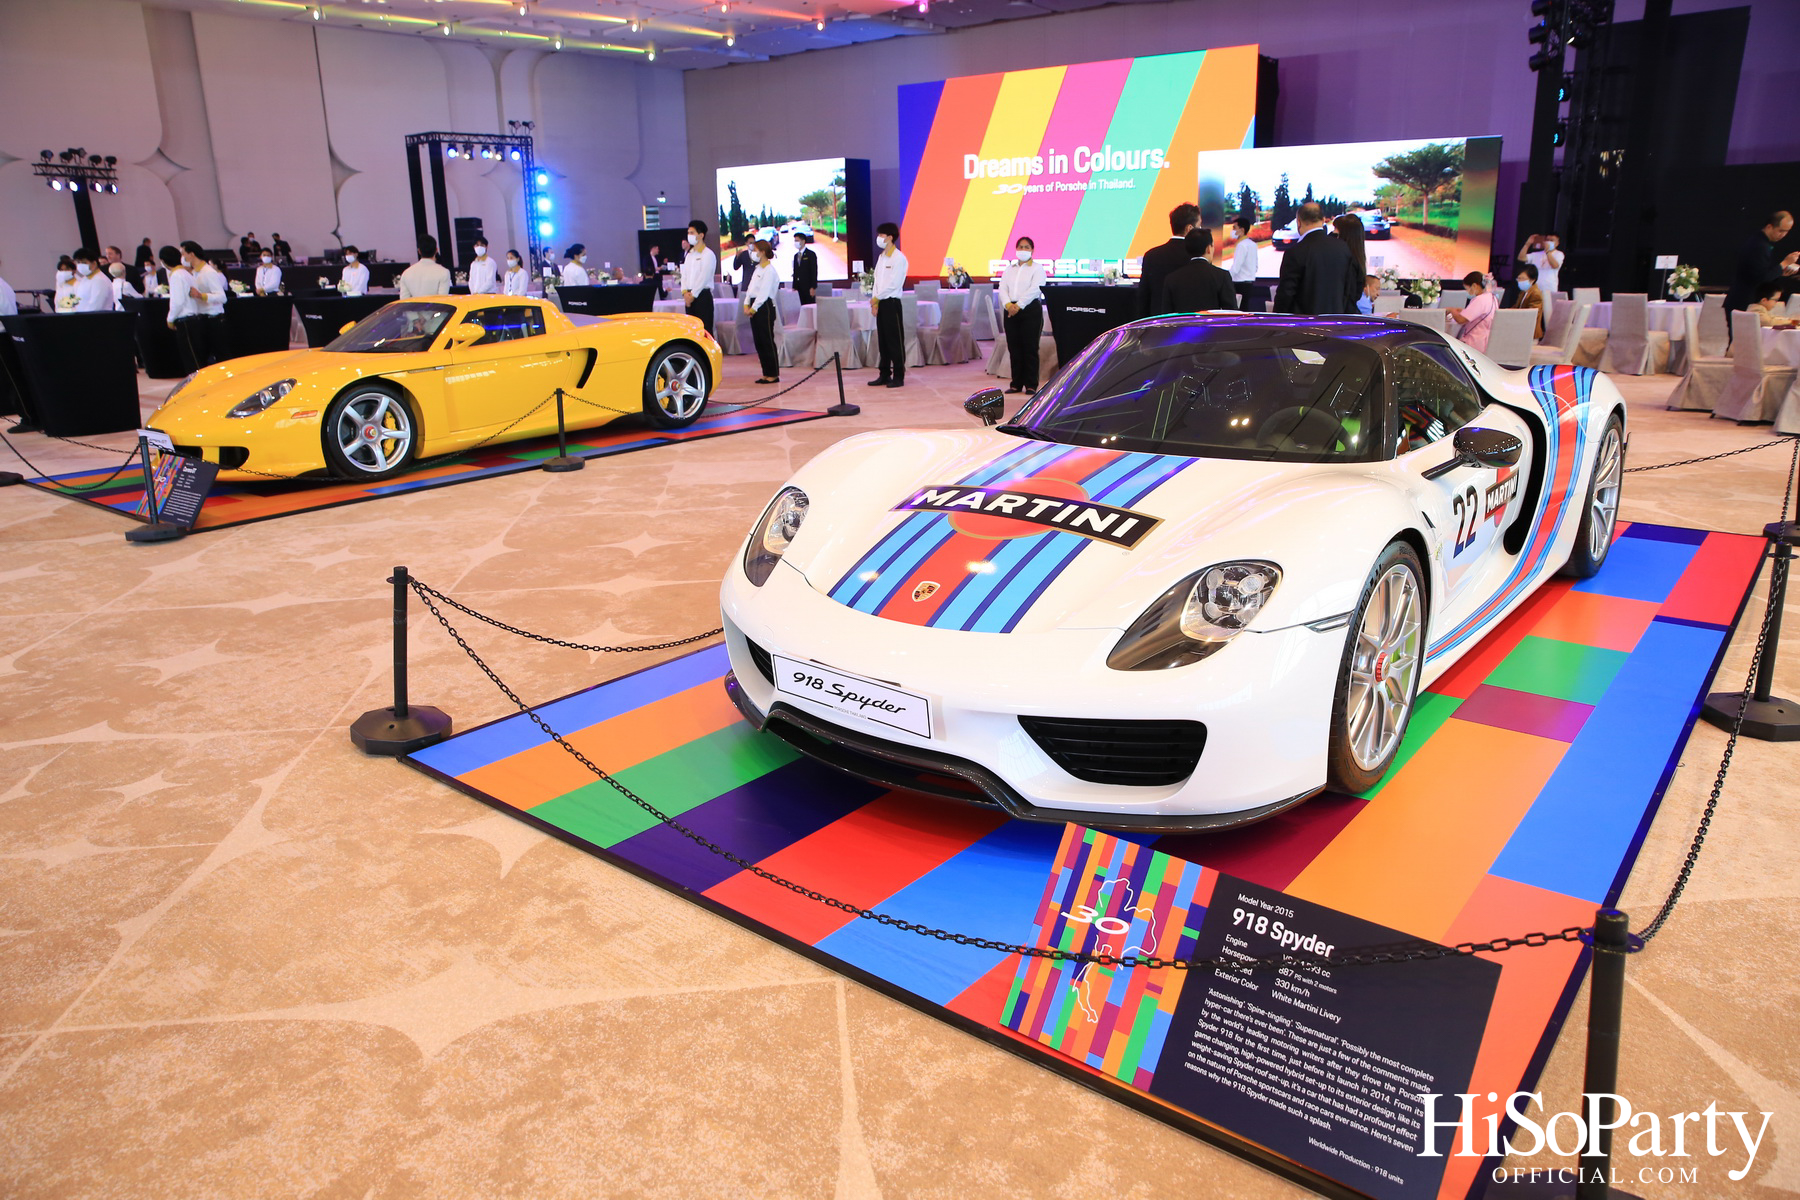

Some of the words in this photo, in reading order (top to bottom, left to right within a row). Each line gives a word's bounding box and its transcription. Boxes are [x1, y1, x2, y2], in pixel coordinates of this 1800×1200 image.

[964, 154, 1043, 179] Dreams
[1048, 149, 1069, 174] in
[1074, 145, 1170, 173] Colours.
[992, 183, 1024, 195] 30
[1023, 183, 1044, 195] years
[1045, 182, 1054, 192] of
[1055, 181, 1087, 192] Porsche
[1088, 180, 1097, 190] in
[1098, 178, 1136, 190] Thailand.
[1066, 306, 1106, 314] PORSCHE
[910, 489, 1139, 538] MARTINI
[1486, 473, 1518, 514] MARTINI
[1452, 484, 1479, 560] 22
[793, 672, 824, 690] 918
[824, 683, 907, 714] Spyder
[1060, 905, 1130, 935] 30
[1238, 893, 1259, 906] Model
[1260, 900, 1274, 911] Year
[1274, 906, 1294, 918] 2015
[1226, 934, 1248, 948] Engine
[1233, 908, 1268, 934] 918
[1270, 921, 1334, 958] Spyder
[1215, 968, 1240, 983] Exterior
[1241, 978, 1259, 990] Color
[1275, 978, 1290, 989] 330
[1291, 984, 1310, 997] km/h
[1279, 968, 1294, 977] 887
[1294, 973, 1302, 981] PS
[1319, 984, 1337, 994] motors
[1322, 970, 1330, 978] cc
[1272, 990, 1292, 1004] White
[1293, 998, 1319, 1014] Martini
[1319, 1008, 1341, 1024] Livery
[1201, 1008, 1209, 1018] by
[1211, 1013, 1221, 1021] the
[1246, 1026, 1268, 1042] leading
[1271, 1038, 1299, 1055] motoring
[1302, 1050, 1324, 1063] writers
[1327, 1060, 1343, 1070] after
[1345, 1067, 1360, 1079] they
[1362, 1074, 1381, 1086] drove
[1384, 1083, 1396, 1092] the
[1205, 998, 1233, 1014] hyper-car
[1254, 1019, 1268, 1028] ever
[1289, 1031, 1307, 1044] These
[1308, 1040, 1318, 1048] are
[1318, 1043, 1332, 1054] just
[1338, 1051, 1351, 1061] few
[1360, 1060, 1371, 1070] the
[1372, 1066, 1409, 1085] comments
[1409, 1080, 1431, 1094] made
[1370, 1051, 1381, 1061] the
[1382, 1057, 1400, 1068] most
[1401, 1064, 1434, 1082] complete
[1194, 1031, 1211, 1041] game
[1212, 1037, 1239, 1054] changing,
[1241, 1048, 1284, 1072] high-powered
[1284, 1066, 1305, 1080] hybrid
[1305, 1077, 1327, 1090] set-up
[1328, 1085, 1335, 1093] to
[1336, 1087, 1344, 1097] its
[1345, 1093, 1371, 1108] exterior
[1372, 1104, 1396, 1120] design,
[1398, 1113, 1410, 1124] like
[1411, 1119, 1420, 1129] its
[1198, 1019, 1219, 1032] Spyder
[1221, 1028, 1233, 1038] 918
[1235, 1034, 1243, 1042] for
[1245, 1039, 1255, 1047] the
[1257, 1043, 1270, 1054] first
[1272, 1049, 1286, 1062] time,
[1288, 1056, 1302, 1067] just
[1304, 1062, 1324, 1076] before
[1326, 1071, 1335, 1080] its
[1337, 1076, 1359, 1090] launch
[1361, 1085, 1368, 1094] in
[1370, 1089, 1390, 1104] 2014.
[1394, 1099, 1412, 1112] From
[1413, 1106, 1425, 1117] its
[1185, 1062, 1207, 1076] reasons
[1208, 1072, 1221, 1082] why
[1221, 1077, 1231, 1086] the
[1233, 1081, 1246, 1092] 918
[1246, 1087, 1268, 1102] Spyder
[1269, 1099, 1287, 1110] made
[1287, 1107, 1303, 1118] such
[1309, 1116, 1331, 1130] splash.
[1192, 1041, 1232, 1064] weight-saving
[1233, 1057, 1255, 1071] Spyder
[1255, 1068, 1269, 1077] roof
[1268, 1074, 1290, 1088] set-up,
[1307, 1090, 1317, 1098] car
[1318, 1094, 1332, 1105] that
[1332, 1099, 1344, 1110] has
[1345, 1104, 1358, 1115] had
[1363, 1114, 1396, 1131] profound
[1396, 1128, 1417, 1141] effect
[1196, 1054, 1206, 1063] the
[1207, 1059, 1226, 1071] nature
[1233, 1069, 1258, 1085] Porsche
[1258, 1082, 1291, 1100] sportscars
[1292, 1096, 1305, 1105] and
[1305, 1102, 1319, 1112] race
[1320, 1108, 1334, 1118] cars
[1335, 1115, 1350, 1124] ever
[1350, 1121, 1369, 1134] since.
[1393, 1139, 1413, 1152] seven
[1309, 1137, 1338, 1155] Worldwide
[1339, 1150, 1370, 1169] Production
[1375, 1166, 1387, 1177] 918
[1388, 1174, 1403, 1184] units
